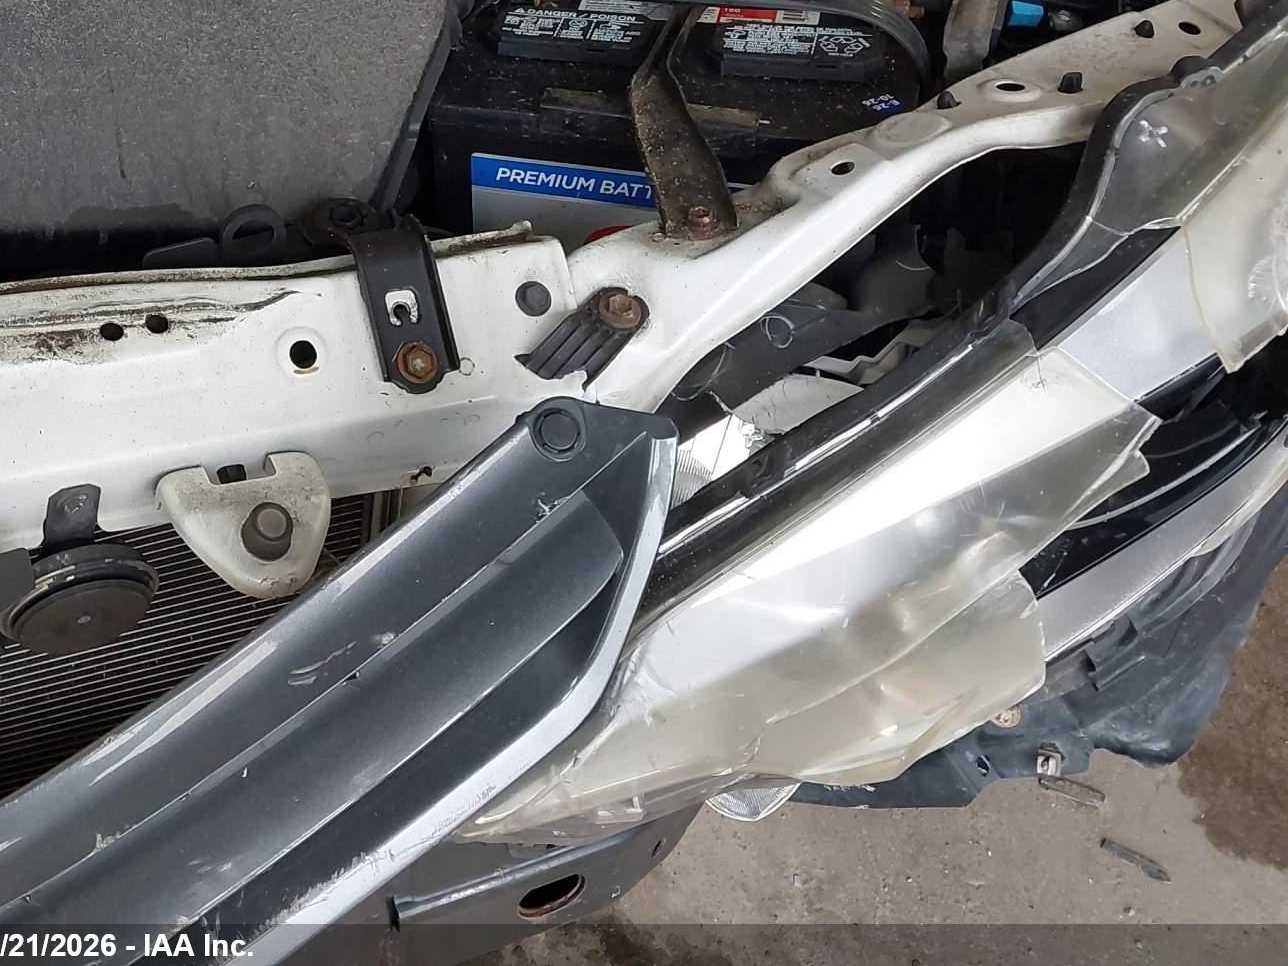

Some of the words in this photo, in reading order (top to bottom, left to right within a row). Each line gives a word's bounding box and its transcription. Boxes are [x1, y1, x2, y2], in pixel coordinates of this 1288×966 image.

[527, 8, 577, 18] DANGER
[590, 13, 636, 21] POISON
[495, 167, 596, 192] PREMIUM
[599, 180, 653, 200] BATT
